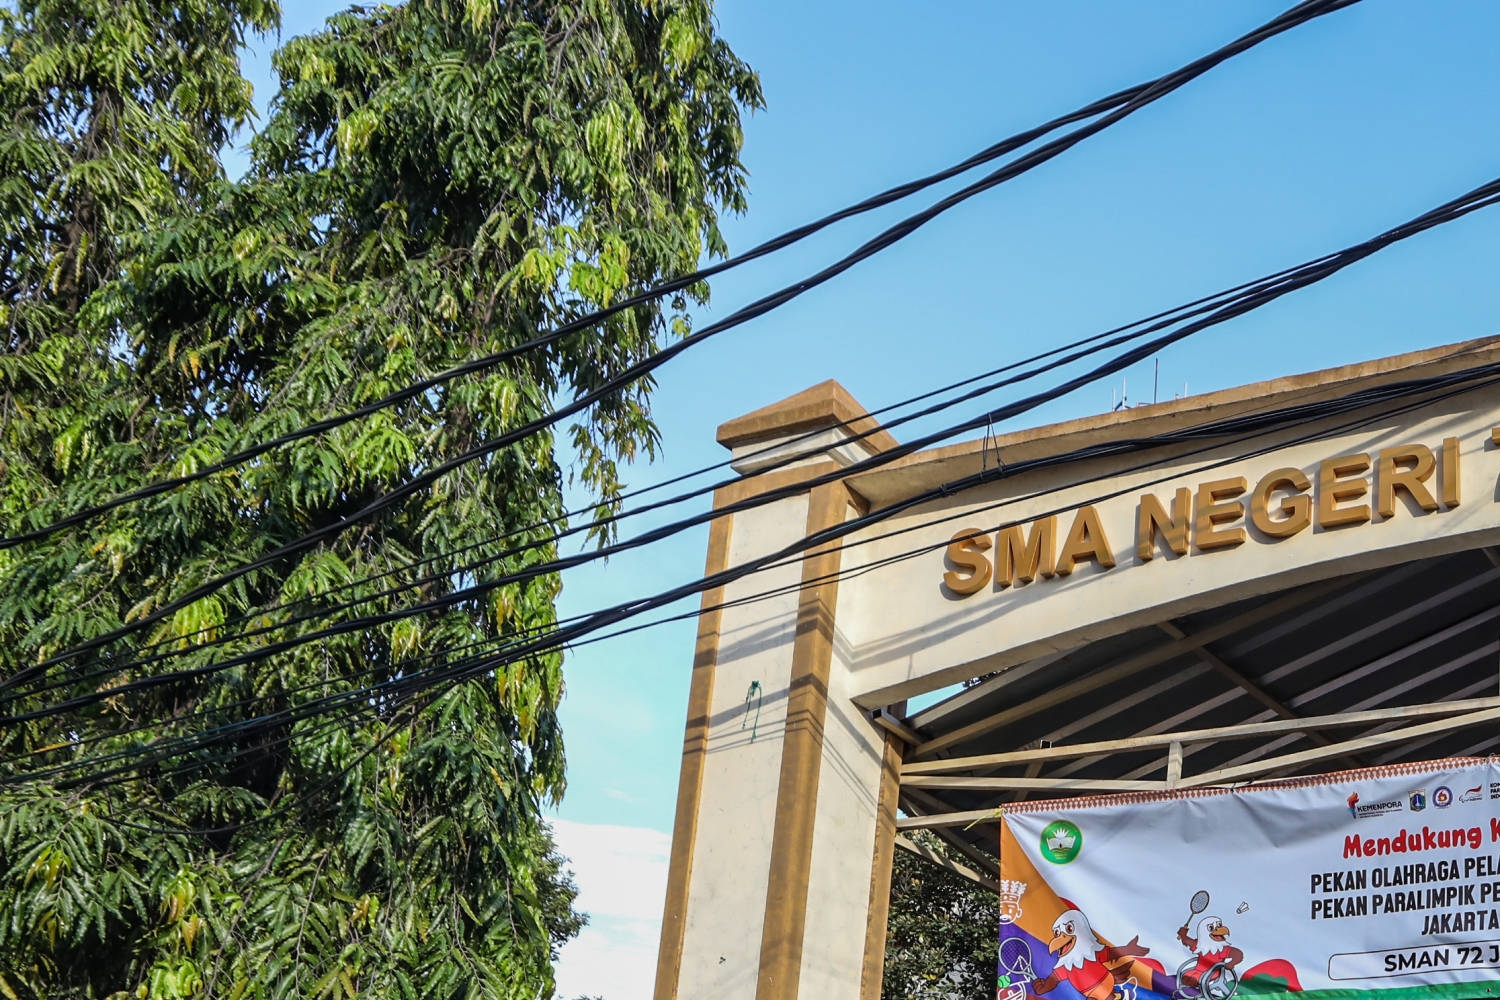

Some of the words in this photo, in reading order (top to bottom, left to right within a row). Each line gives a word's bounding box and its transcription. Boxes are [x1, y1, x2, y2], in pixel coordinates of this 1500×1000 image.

[943, 505, 1116, 595] SMA
[1137, 436, 1461, 561] NEGERI
[1357, 801, 1403, 813] KEMENPORA
[1343, 826, 1482, 859] Mendukung
[1310, 869, 1368, 894] PEKAN
[1371, 862, 1460, 889] OLAHRAGA
[1310, 896, 1368, 920] PEKAN
[1372, 885, 1476, 914] PARALIMPIK
[1421, 909, 1500, 936] JAKARTA
[1384, 946, 1450, 972] SMAN
[1456, 946, 1485, 965] 72
